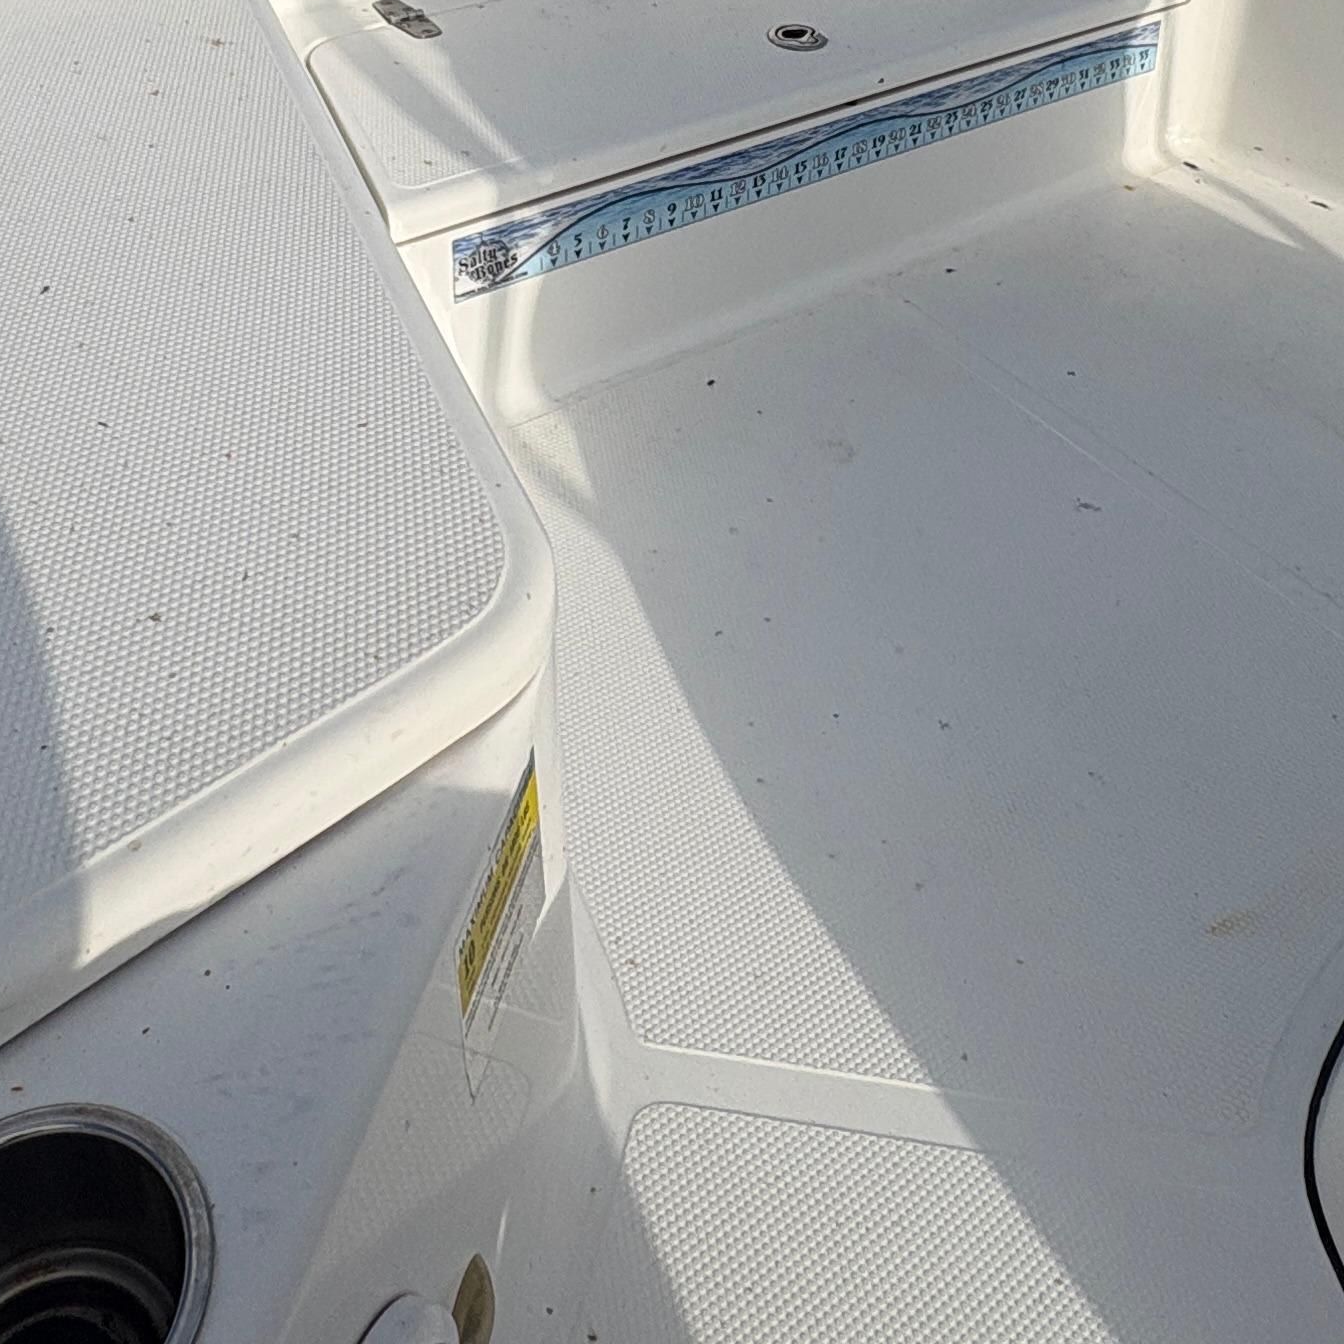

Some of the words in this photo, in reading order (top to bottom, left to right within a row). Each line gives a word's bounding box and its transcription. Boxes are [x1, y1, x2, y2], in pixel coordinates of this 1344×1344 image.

[574, 232, 582, 247] 5
[622, 217, 631, 231] 7
[643, 209, 656, 224] 8
[667, 202, 678, 217] 9
[684, 194, 705, 212] 10
[710, 187, 723, 202] 11
[730, 179, 746, 197] 12
[752, 175, 766, 188] 13
[794, 159, 807, 174] 15
[834, 146, 848, 162] 17
[851, 140, 868, 156] 18
[871, 135, 886, 149] 19
[909, 122, 922, 136] 21
[945, 111, 958, 125] 23
[980, 98, 993, 113] 25
[1014, 87, 1027, 102] 27
[1046, 78, 1059, 92] 29
[458, 248, 498, 276] Salty
[469, 253, 518, 281] Bones
